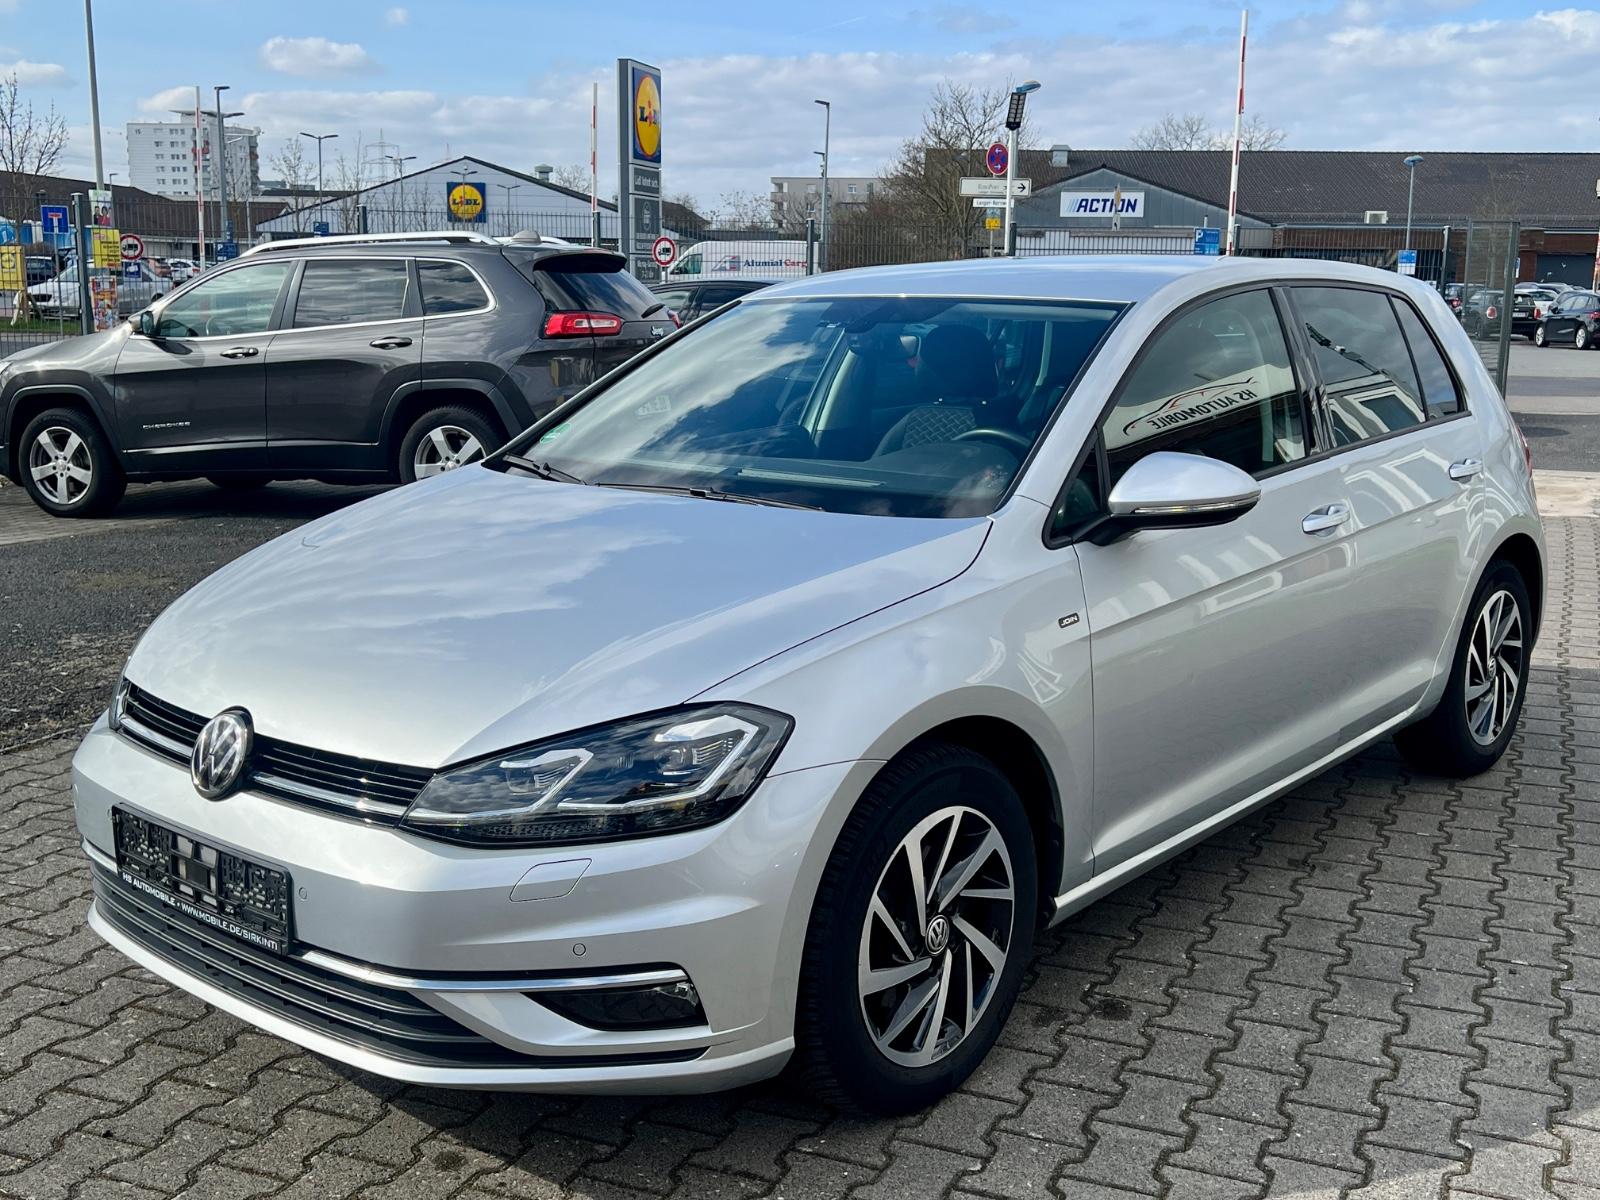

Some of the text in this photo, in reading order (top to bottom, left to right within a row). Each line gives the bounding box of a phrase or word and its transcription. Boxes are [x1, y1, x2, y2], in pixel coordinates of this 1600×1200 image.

[1195, 230, 1204, 242] P
[784, 259, 807, 269] Carg
[133, 876, 176, 907] AUTOMOBILE
